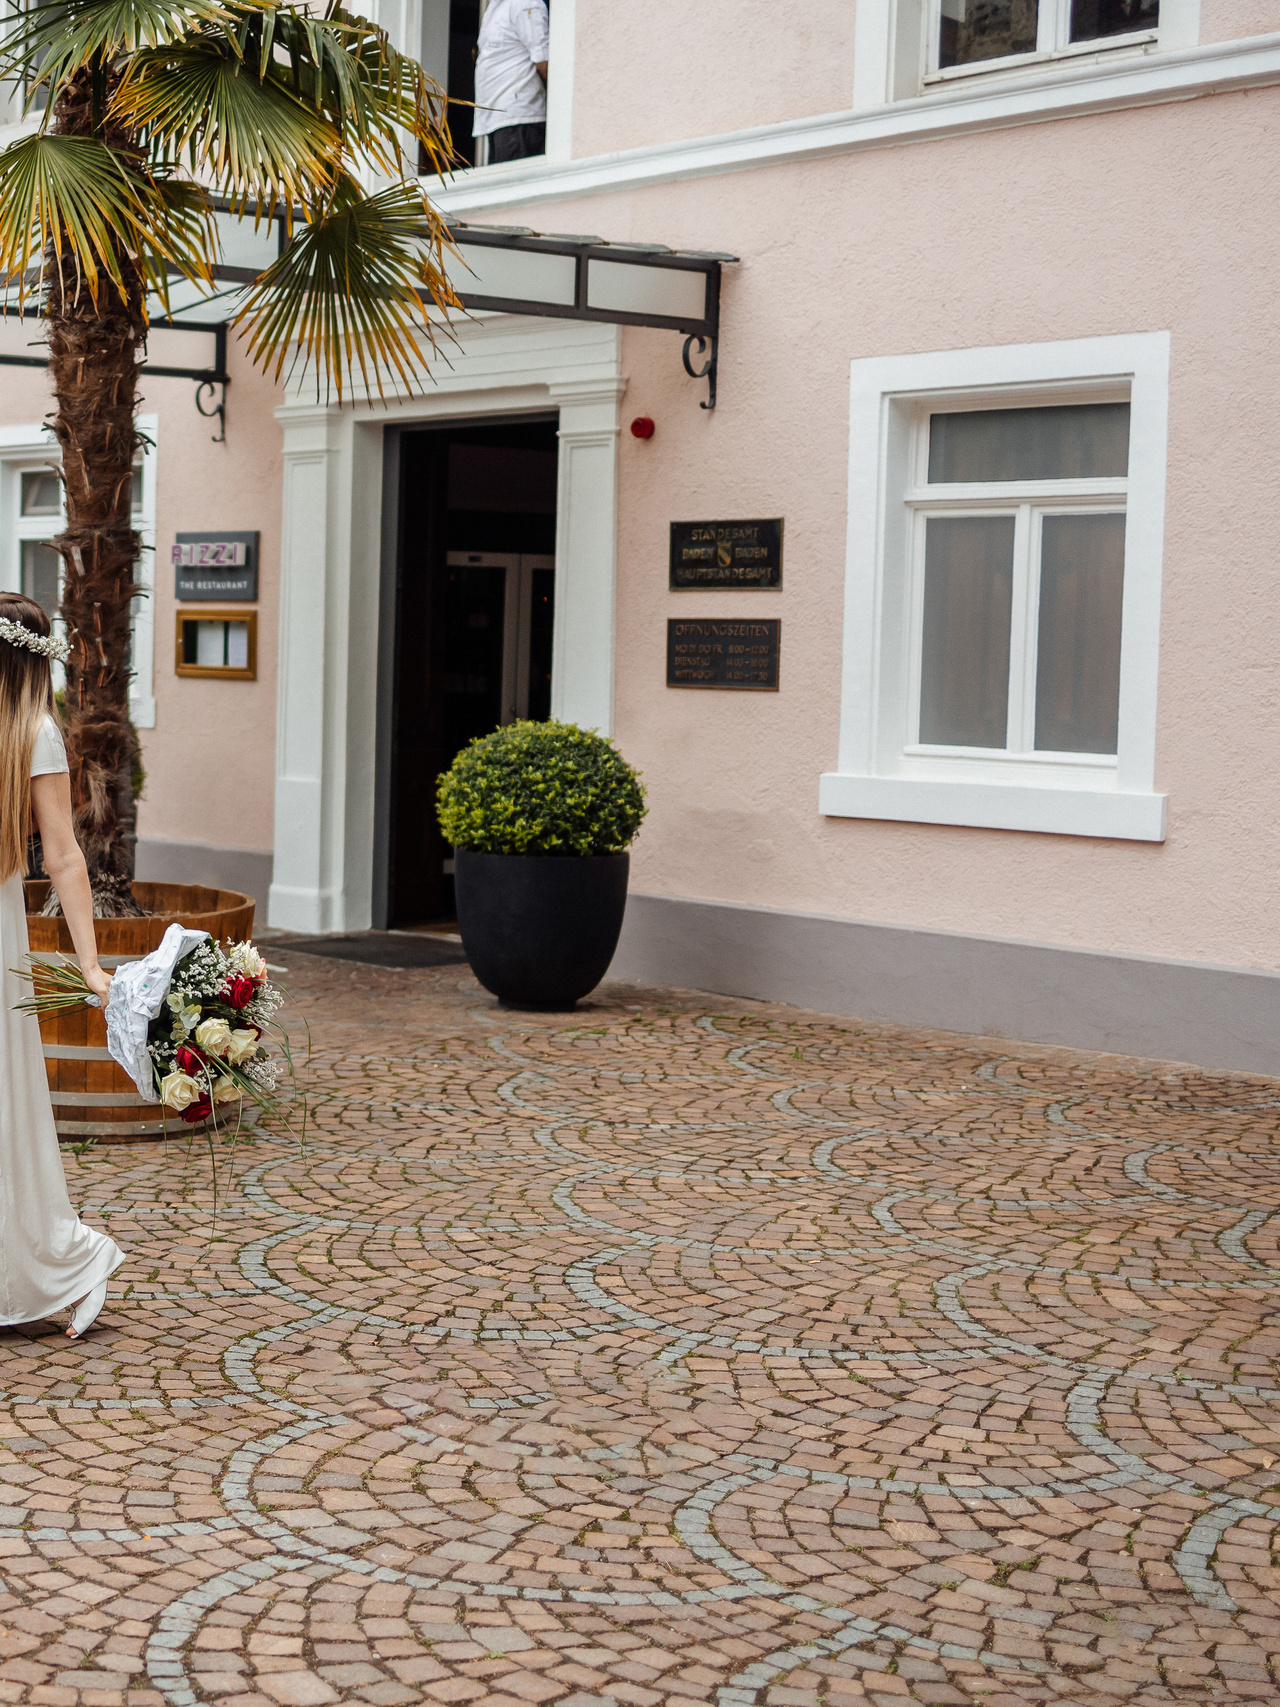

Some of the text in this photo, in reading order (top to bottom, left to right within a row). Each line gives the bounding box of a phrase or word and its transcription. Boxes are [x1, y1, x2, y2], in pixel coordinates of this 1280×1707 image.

[691, 527, 759, 540] STANDESAMT
[171, 543, 240, 566] RIZZI
[682, 546, 768, 560] BADEN BADEN
[180, 581, 248, 590] THE RESTAURANT
